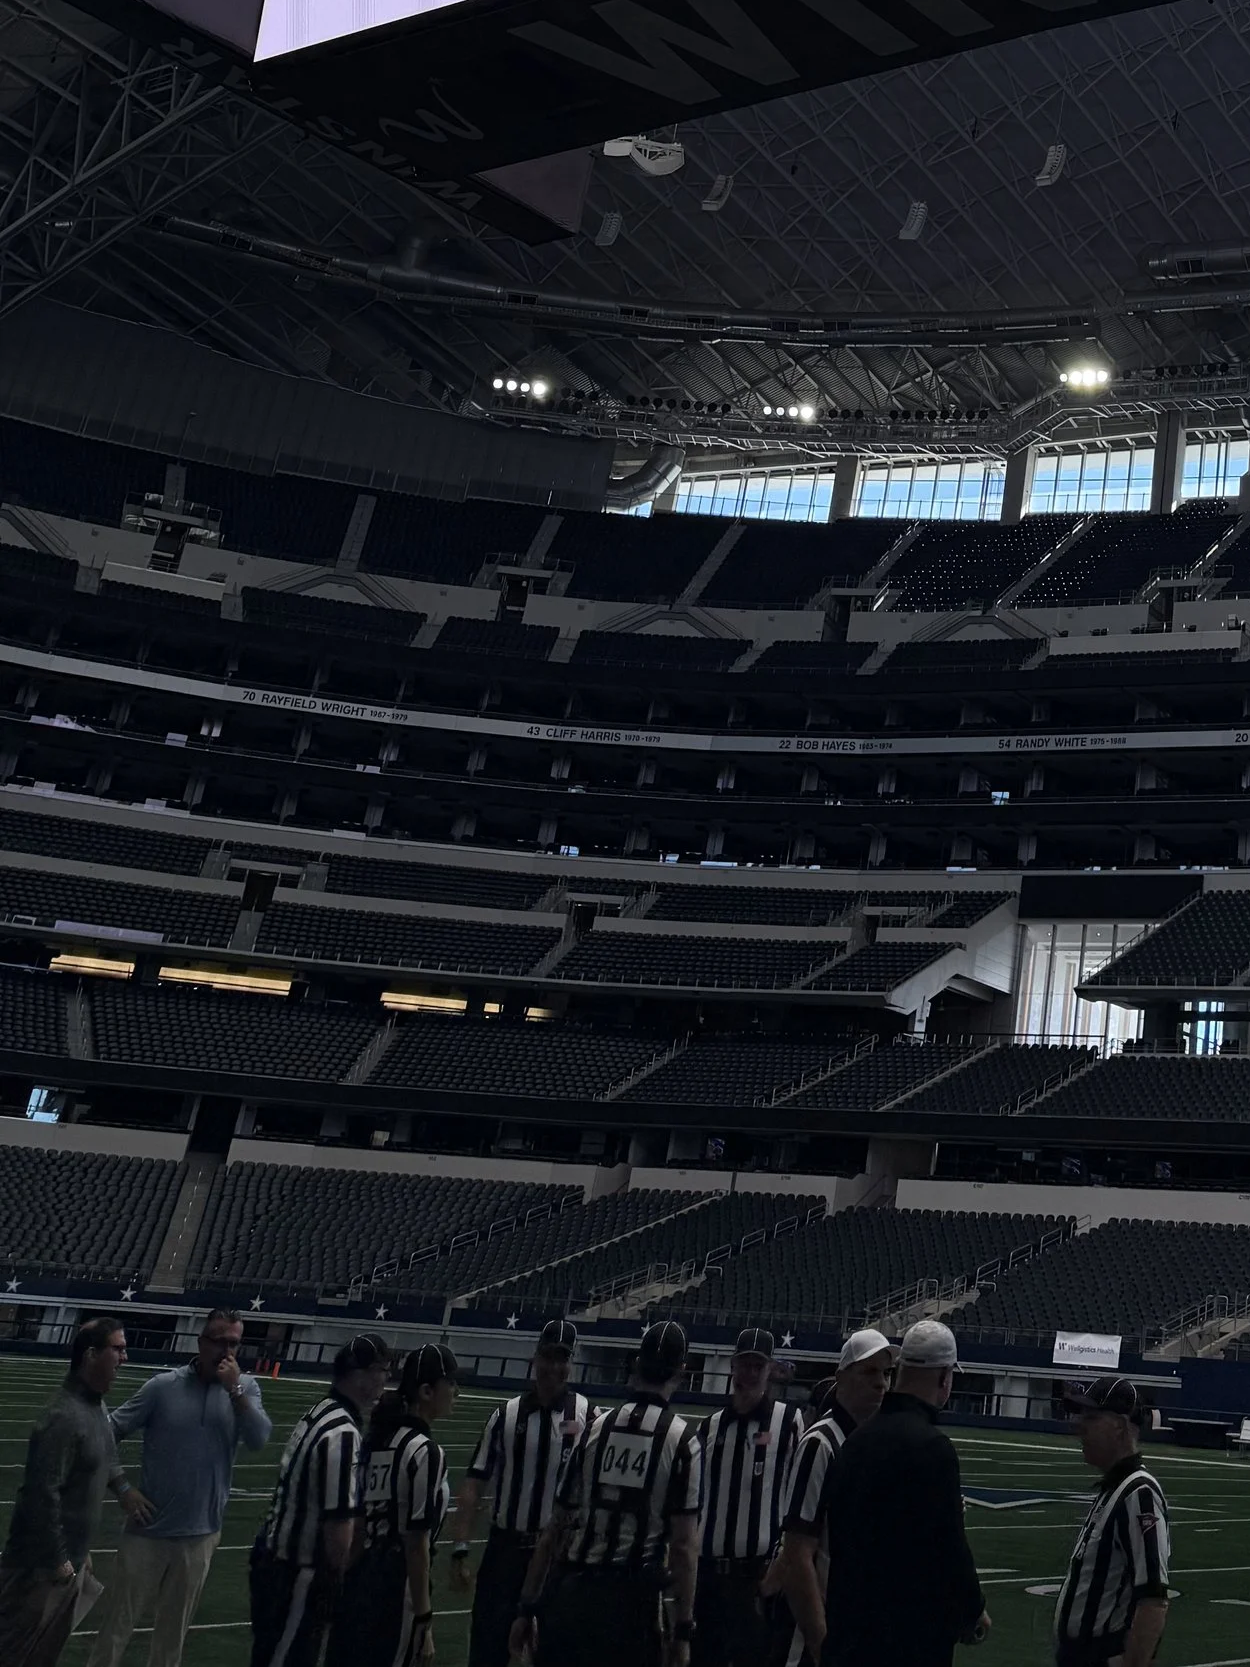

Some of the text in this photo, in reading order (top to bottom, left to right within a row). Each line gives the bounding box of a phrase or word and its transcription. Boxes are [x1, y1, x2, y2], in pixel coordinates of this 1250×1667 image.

[242, 690, 256, 701] 70
[261, 693, 317, 710] RAYFIELD
[321, 701, 367, 717] WRIGHT
[527, 725, 541, 736] 43
[546, 728, 578, 739] CLIFF
[581, 730, 621, 742] HARRIS
[1235, 733, 1248, 743] 20
[779, 739, 791, 749] 22
[796, 740, 819, 750] BOB
[822, 741, 856, 751] HAYES
[998, 739, 1011, 749] 54
[1015, 737, 1050, 749] RANDY
[1054, 737, 1087, 747] WHITE
[603, 1444, 648, 1478] 044
